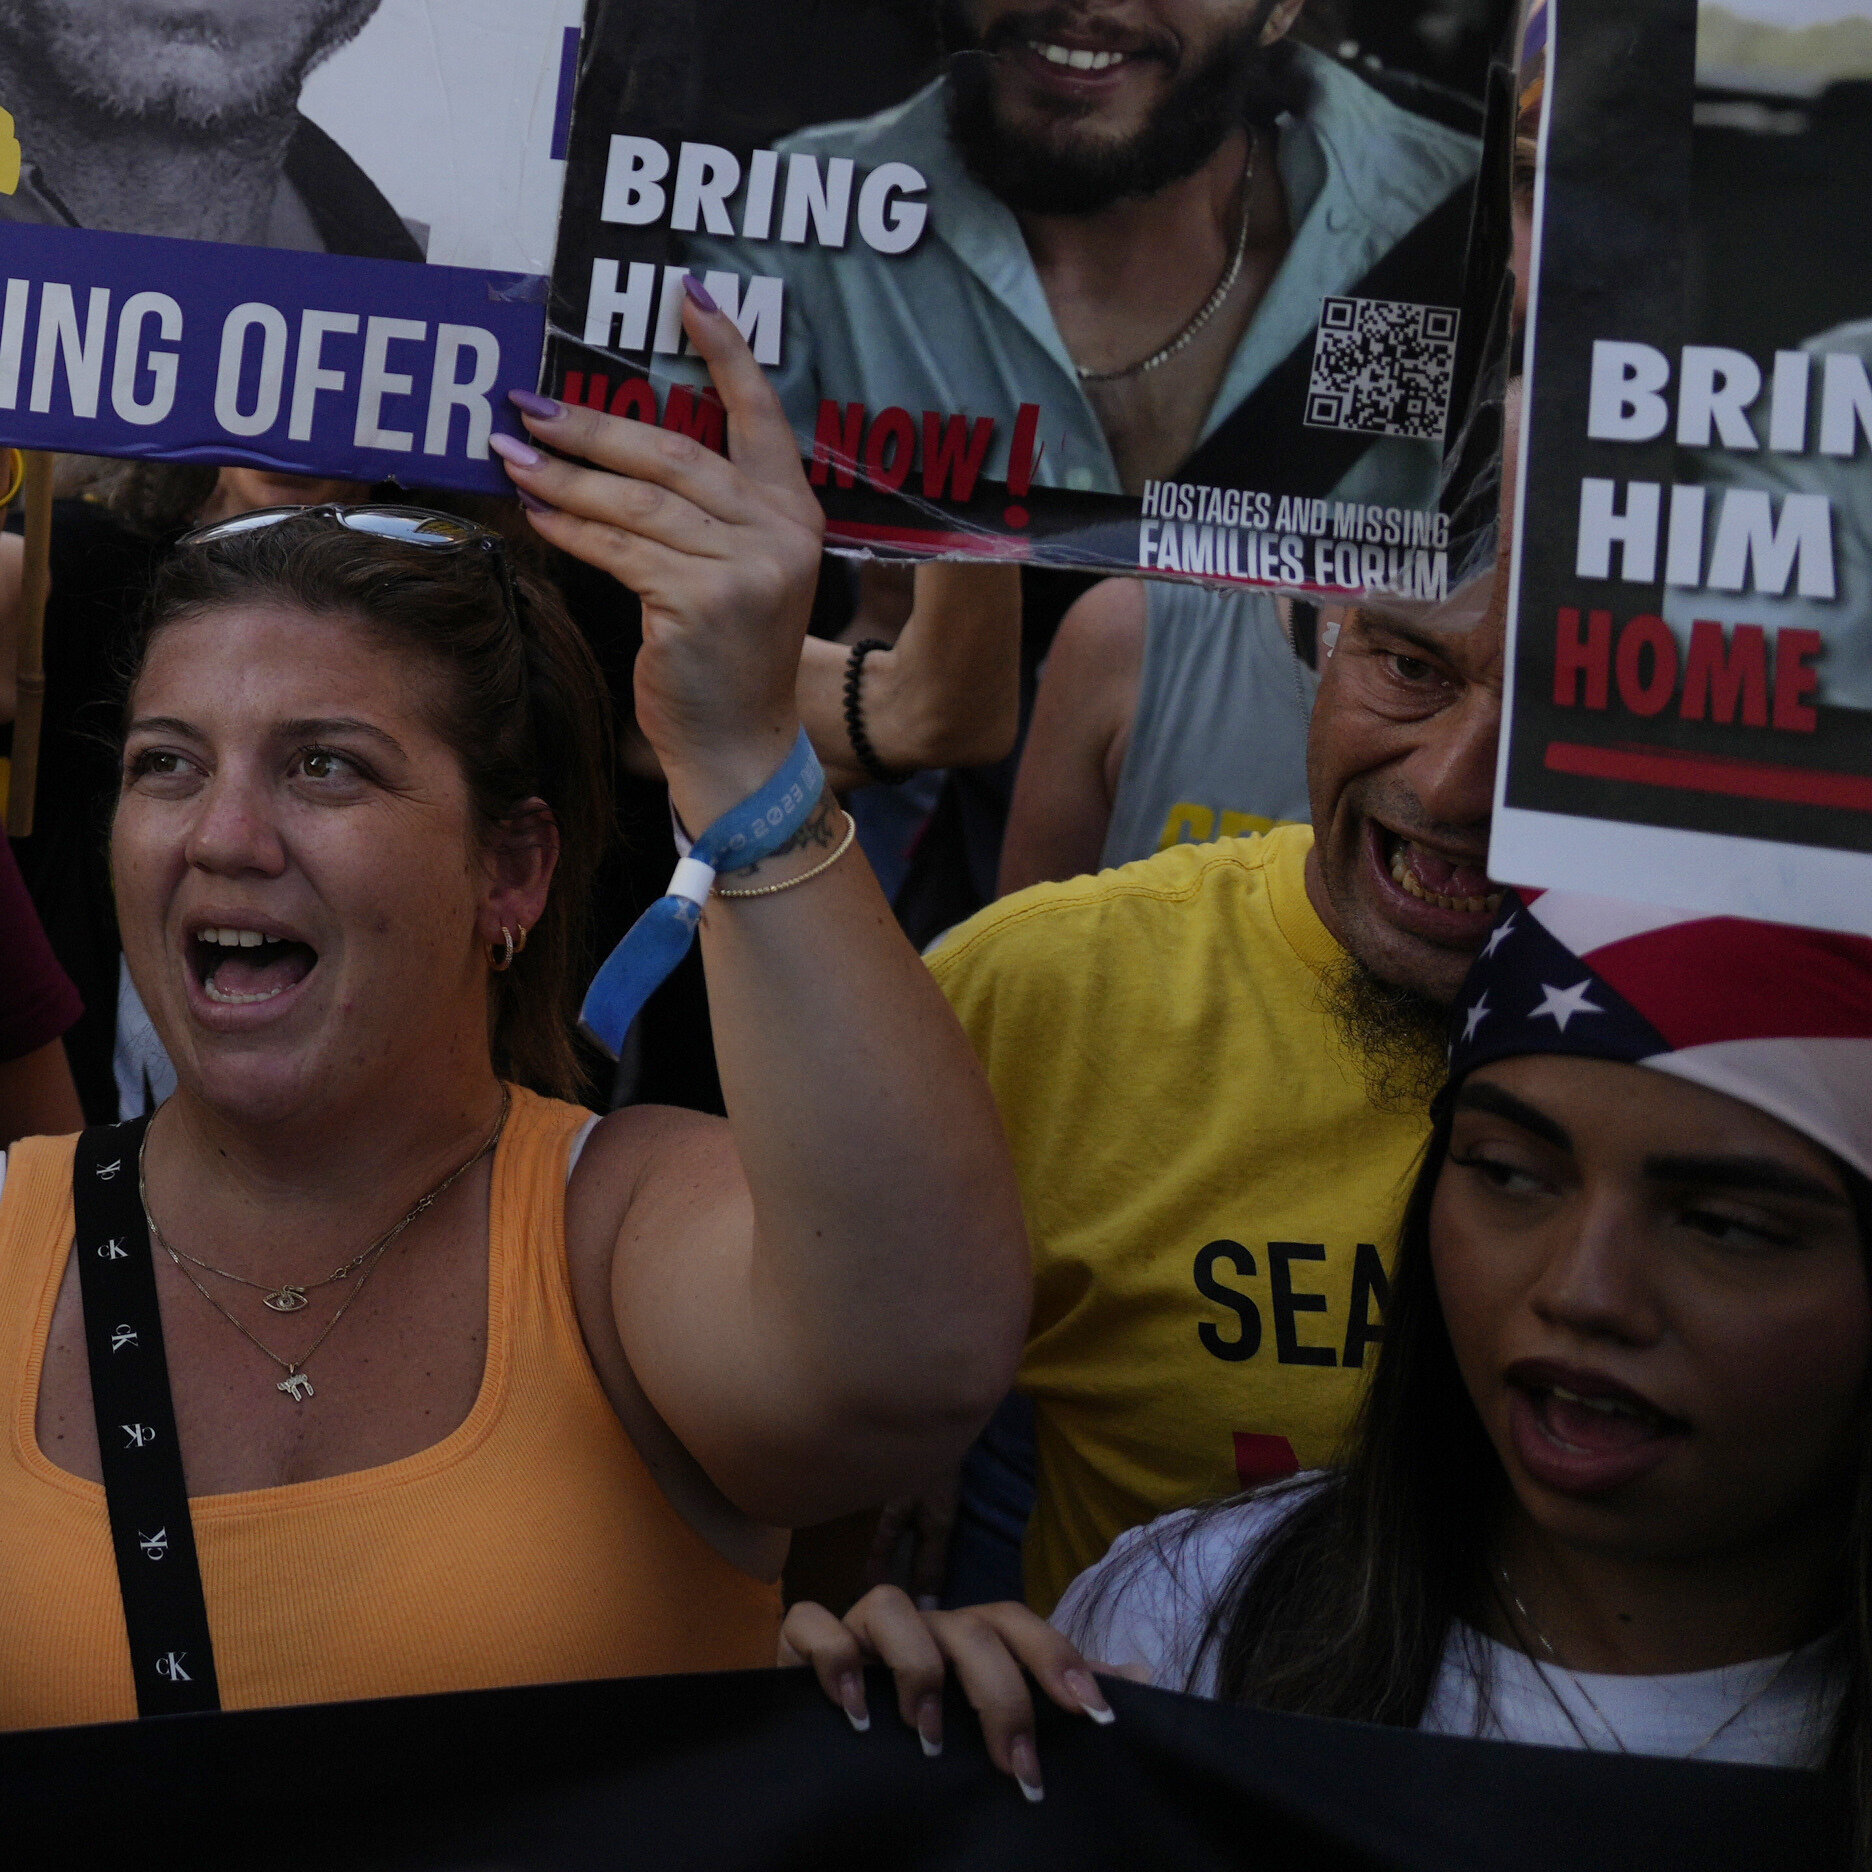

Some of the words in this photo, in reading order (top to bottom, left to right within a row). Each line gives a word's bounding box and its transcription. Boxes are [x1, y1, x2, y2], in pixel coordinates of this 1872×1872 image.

[599, 133, 929, 256] BRING
[583, 257, 783, 366] HIM
[213, 301, 500, 461] OFER
[562, 370, 728, 459] OM
[810, 399, 1044, 528] NOW!
[1139, 518, 1304, 584] FAMILIES
[1314, 539, 1448, 602] FORUM
[1141, 479, 1271, 529] HOSTAGES
[1275, 495, 1327, 536] AND
[1332, 501, 1450, 549] MISSING
[1575, 477, 1836, 599] HIM
[1553, 606, 1822, 734] HOME
